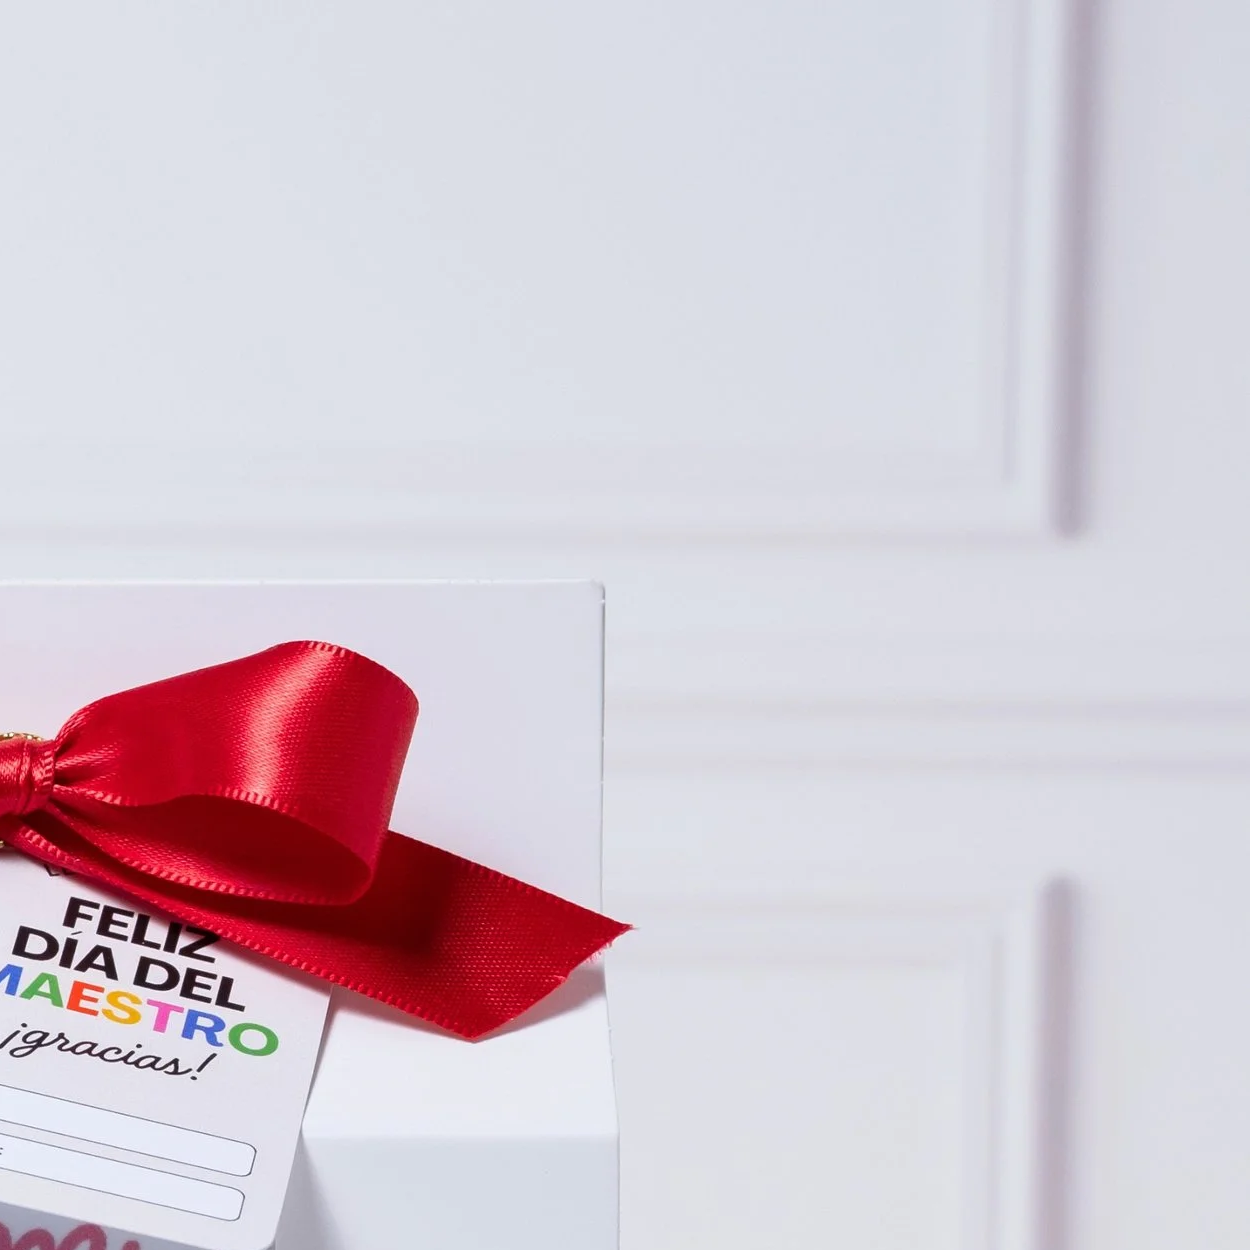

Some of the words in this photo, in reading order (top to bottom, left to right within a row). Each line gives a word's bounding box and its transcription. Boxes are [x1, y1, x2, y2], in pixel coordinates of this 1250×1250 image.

[11, 925, 120, 981] DÍA
[133, 955, 246, 1012] DEL
[62, 896, 221, 964] FELIZ
